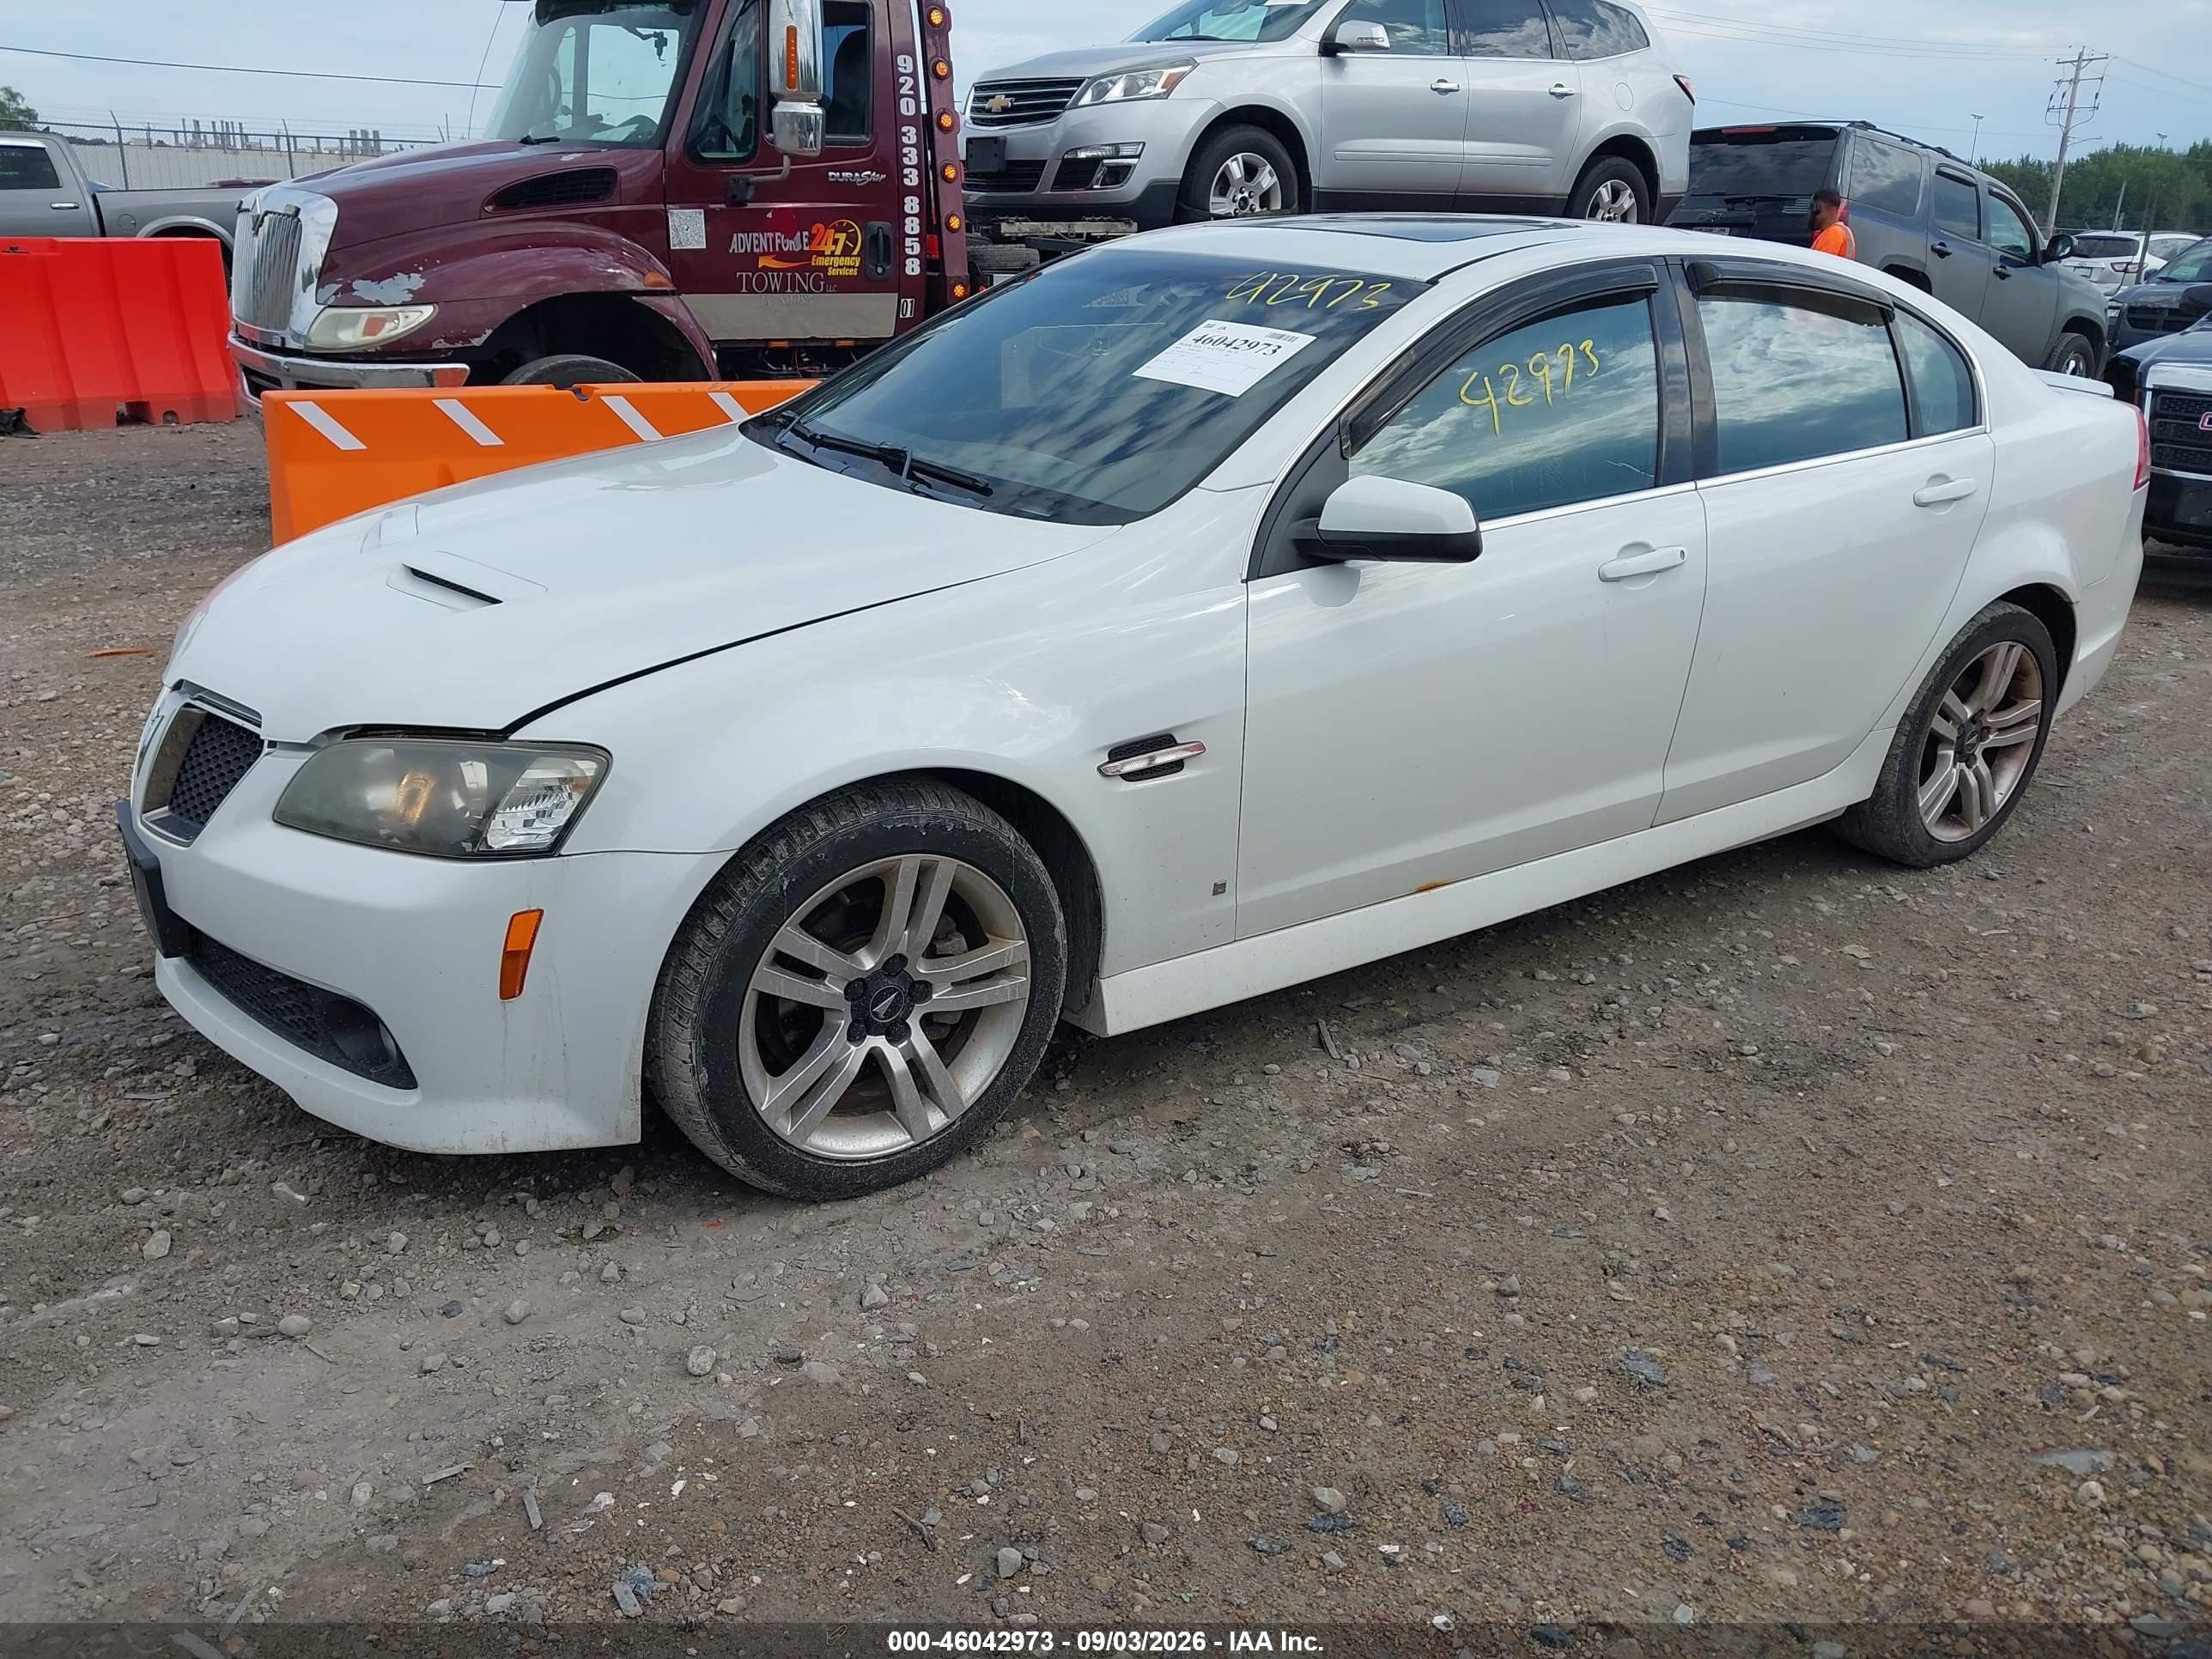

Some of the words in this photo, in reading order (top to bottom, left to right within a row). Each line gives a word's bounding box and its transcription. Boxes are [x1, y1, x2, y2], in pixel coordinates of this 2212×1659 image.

[896, 54, 915, 116] 920
[902, 125, 920, 186] 333
[903, 196, 921, 276] 8858
[811, 254, 861, 268] Emergency
[827, 266, 858, 276] Services
[736, 271, 825, 293] TOWING
[826, 284, 838, 293] LLC
[1225, 270, 1393, 311] 42973
[902, 300, 915, 317] 01
[1192, 333, 1283, 356] 46042973
[1460, 338, 1600, 438] 42973
